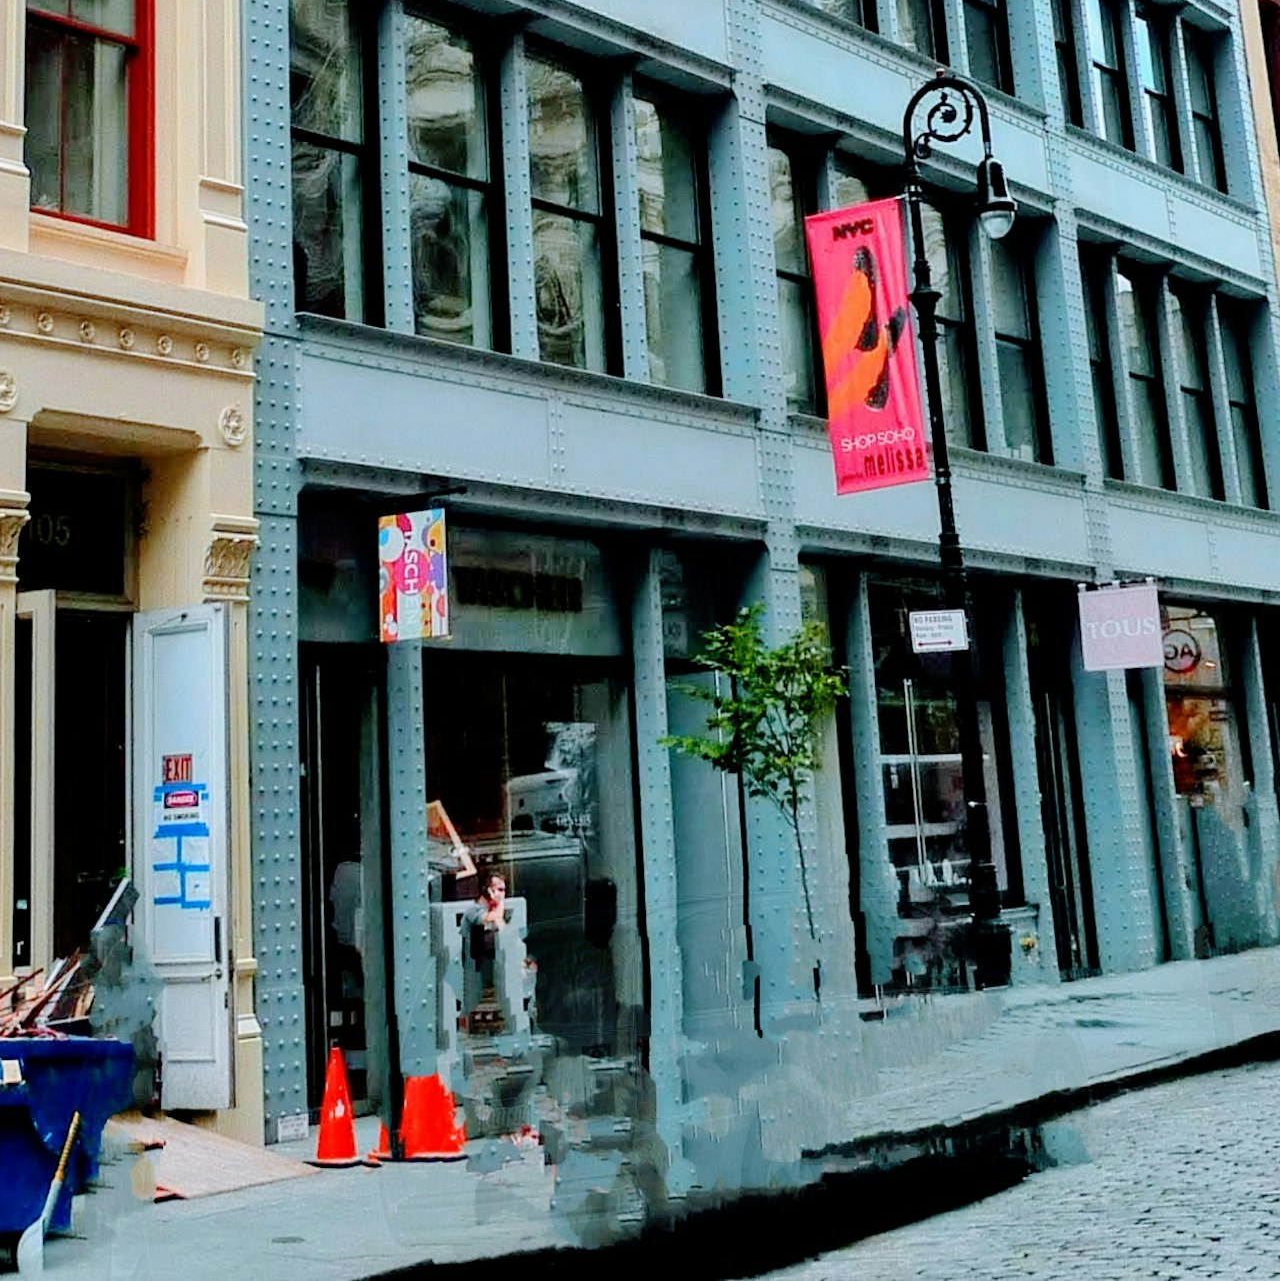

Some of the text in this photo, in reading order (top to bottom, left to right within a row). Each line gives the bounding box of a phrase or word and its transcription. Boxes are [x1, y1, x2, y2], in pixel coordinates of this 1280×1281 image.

[832, 218, 875, 243] NYC
[840, 426, 916, 453] SHOP SOHO
[863, 445, 923, 478] melissa
[1087, 616, 1155, 640] TOUS
[165, 756, 193, 782] EXIT
